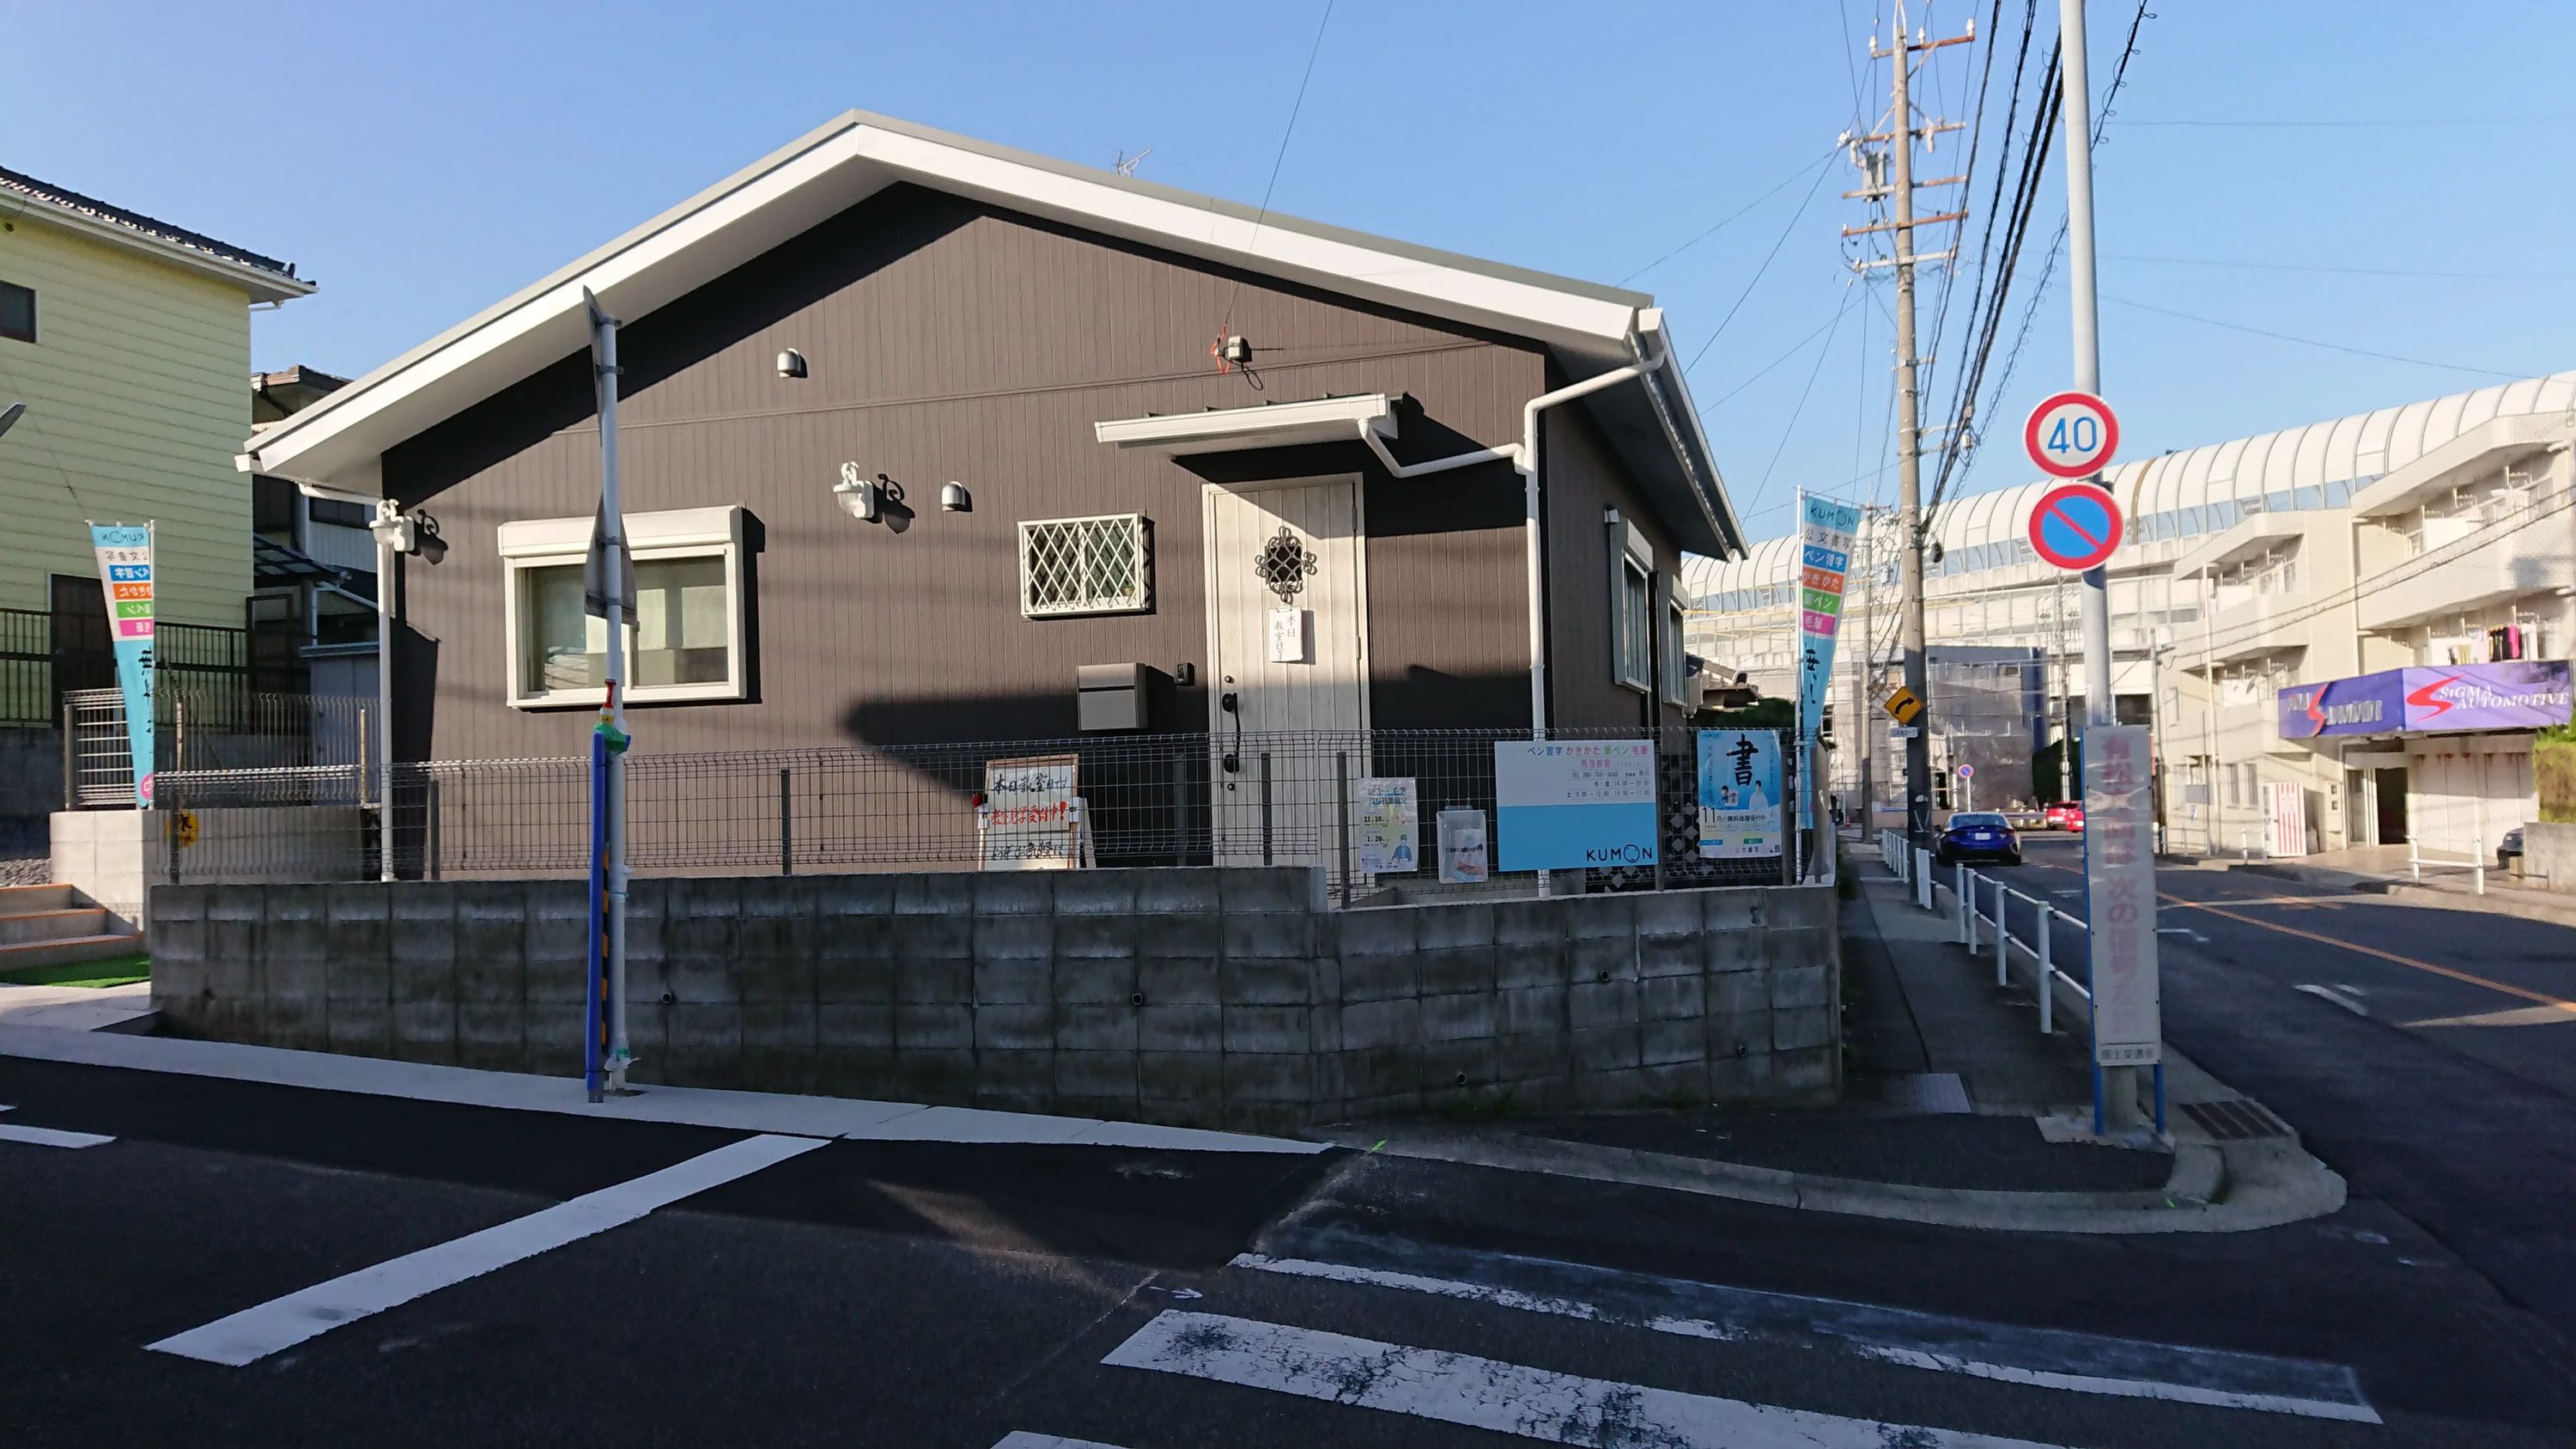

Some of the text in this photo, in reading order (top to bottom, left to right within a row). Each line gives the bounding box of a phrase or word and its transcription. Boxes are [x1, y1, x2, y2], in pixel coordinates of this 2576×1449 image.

[2048, 417, 2097, 454] 40
[1810, 506, 1855, 527] KUMON
[1805, 528, 1851, 550] 公文書写
[1804, 550, 1844, 569] ペン習字
[1802, 570, 1839, 590] かきかた
[2456, 691, 2570, 709] AUTOMOTIVE
[1528, 745, 1649, 756] ペン習字 かきかた 筆ペン 毛筆
[1726, 733, 1759, 786] 書
[1587, 844, 1653, 863] KUMON
